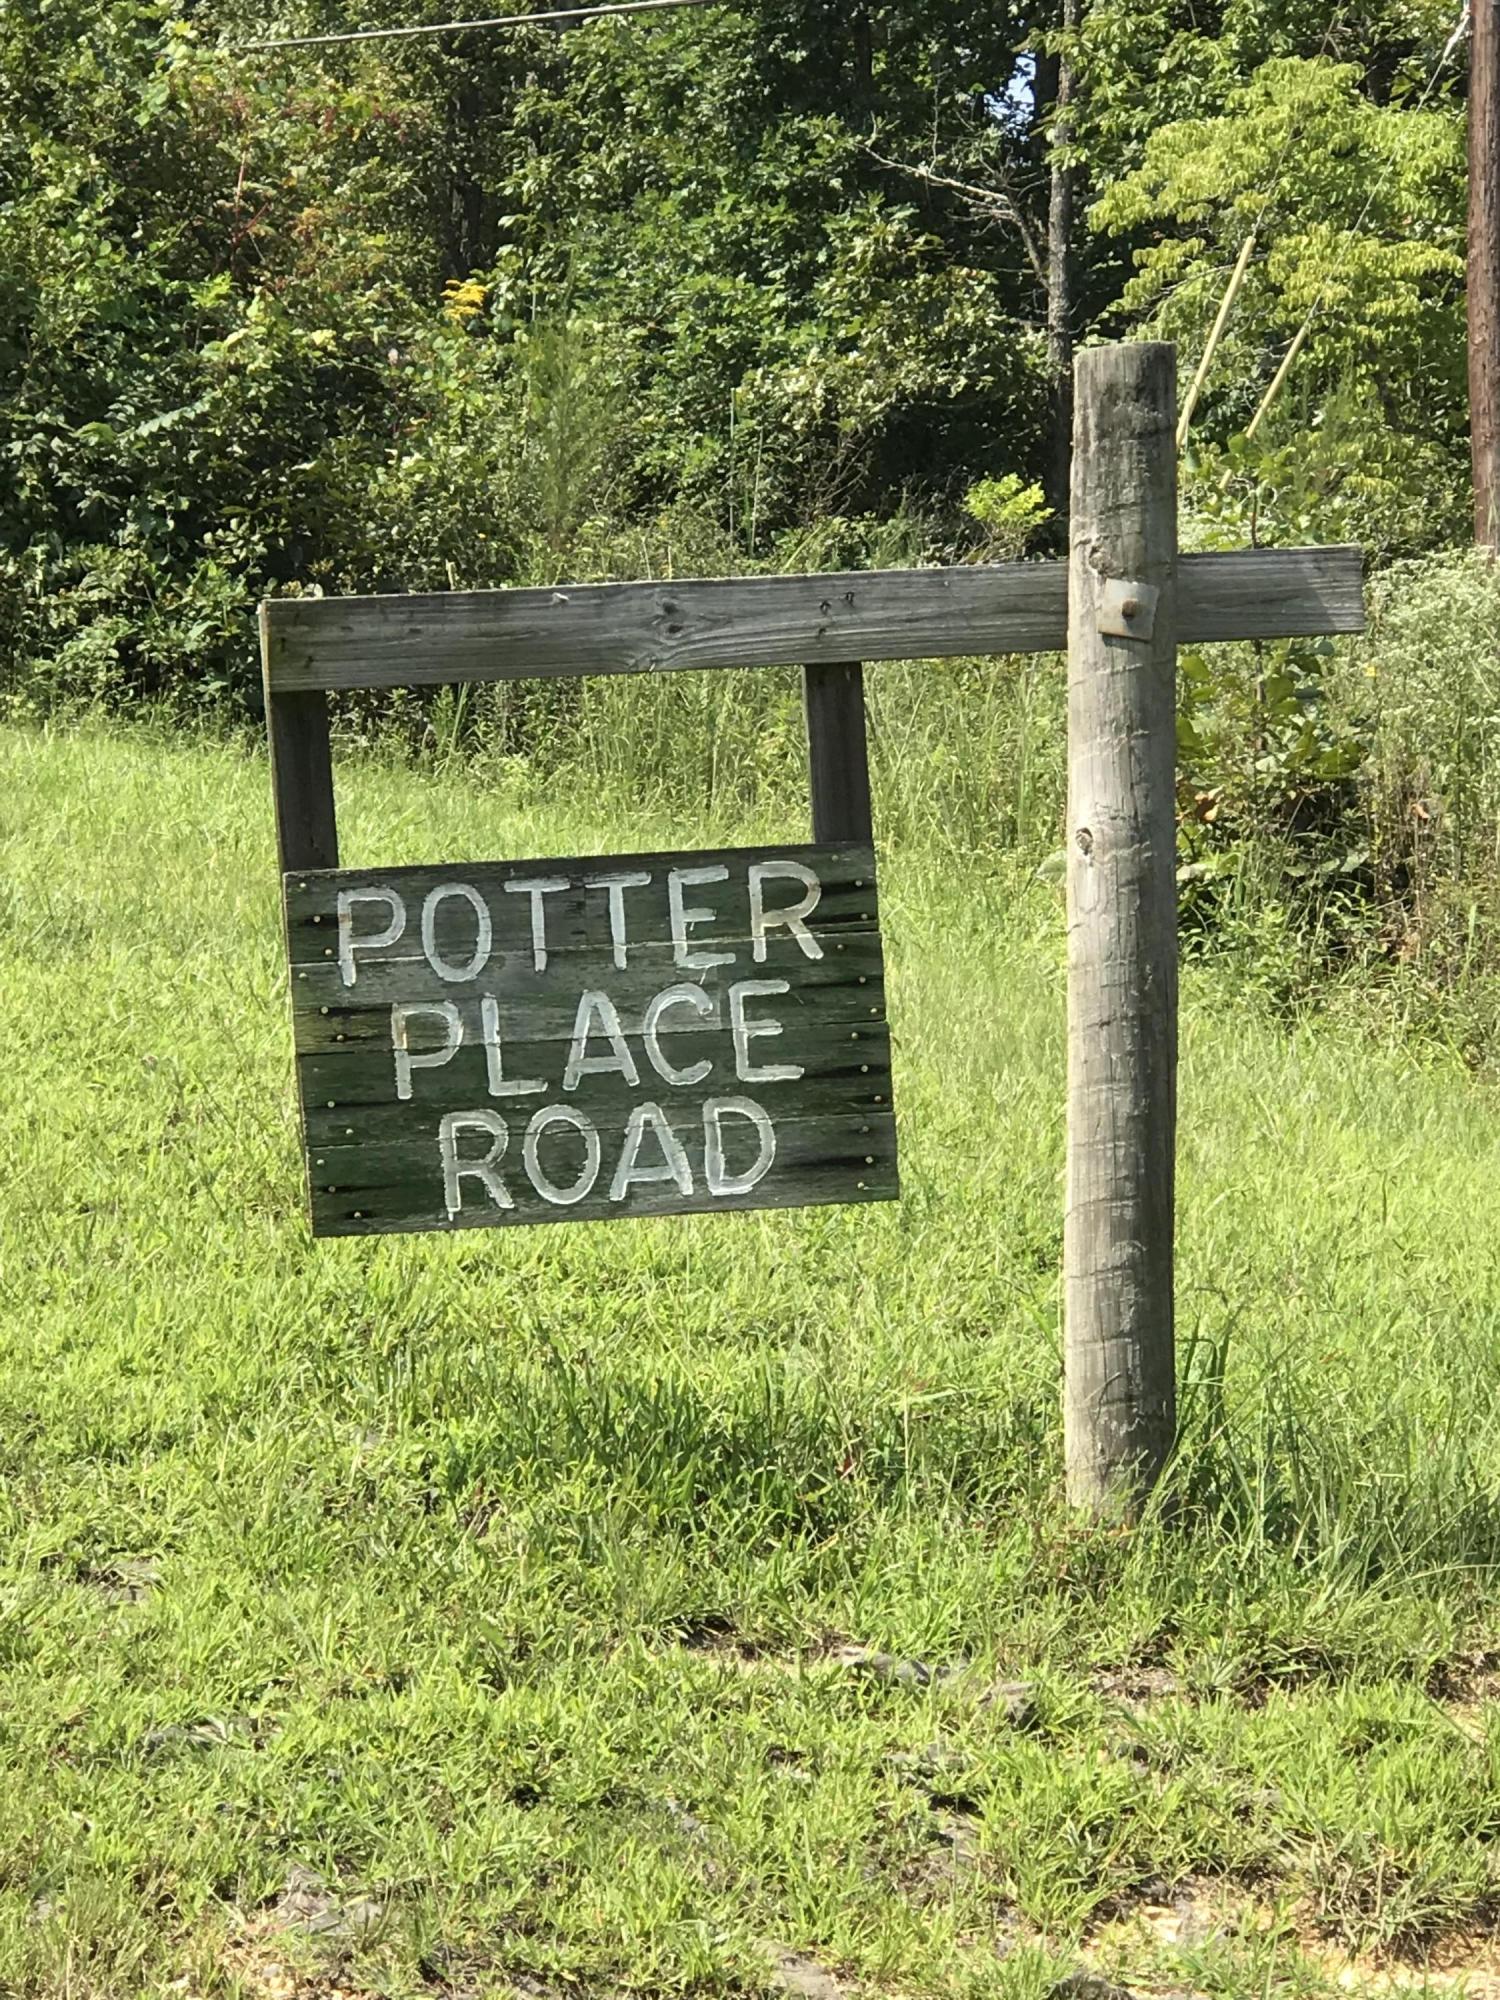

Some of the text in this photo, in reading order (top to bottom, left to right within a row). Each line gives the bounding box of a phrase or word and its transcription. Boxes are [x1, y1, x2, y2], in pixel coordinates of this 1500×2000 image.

[336, 860, 824, 987] POTTER
[391, 980, 805, 1100] PLACE
[439, 1096, 777, 1221] ROAD
